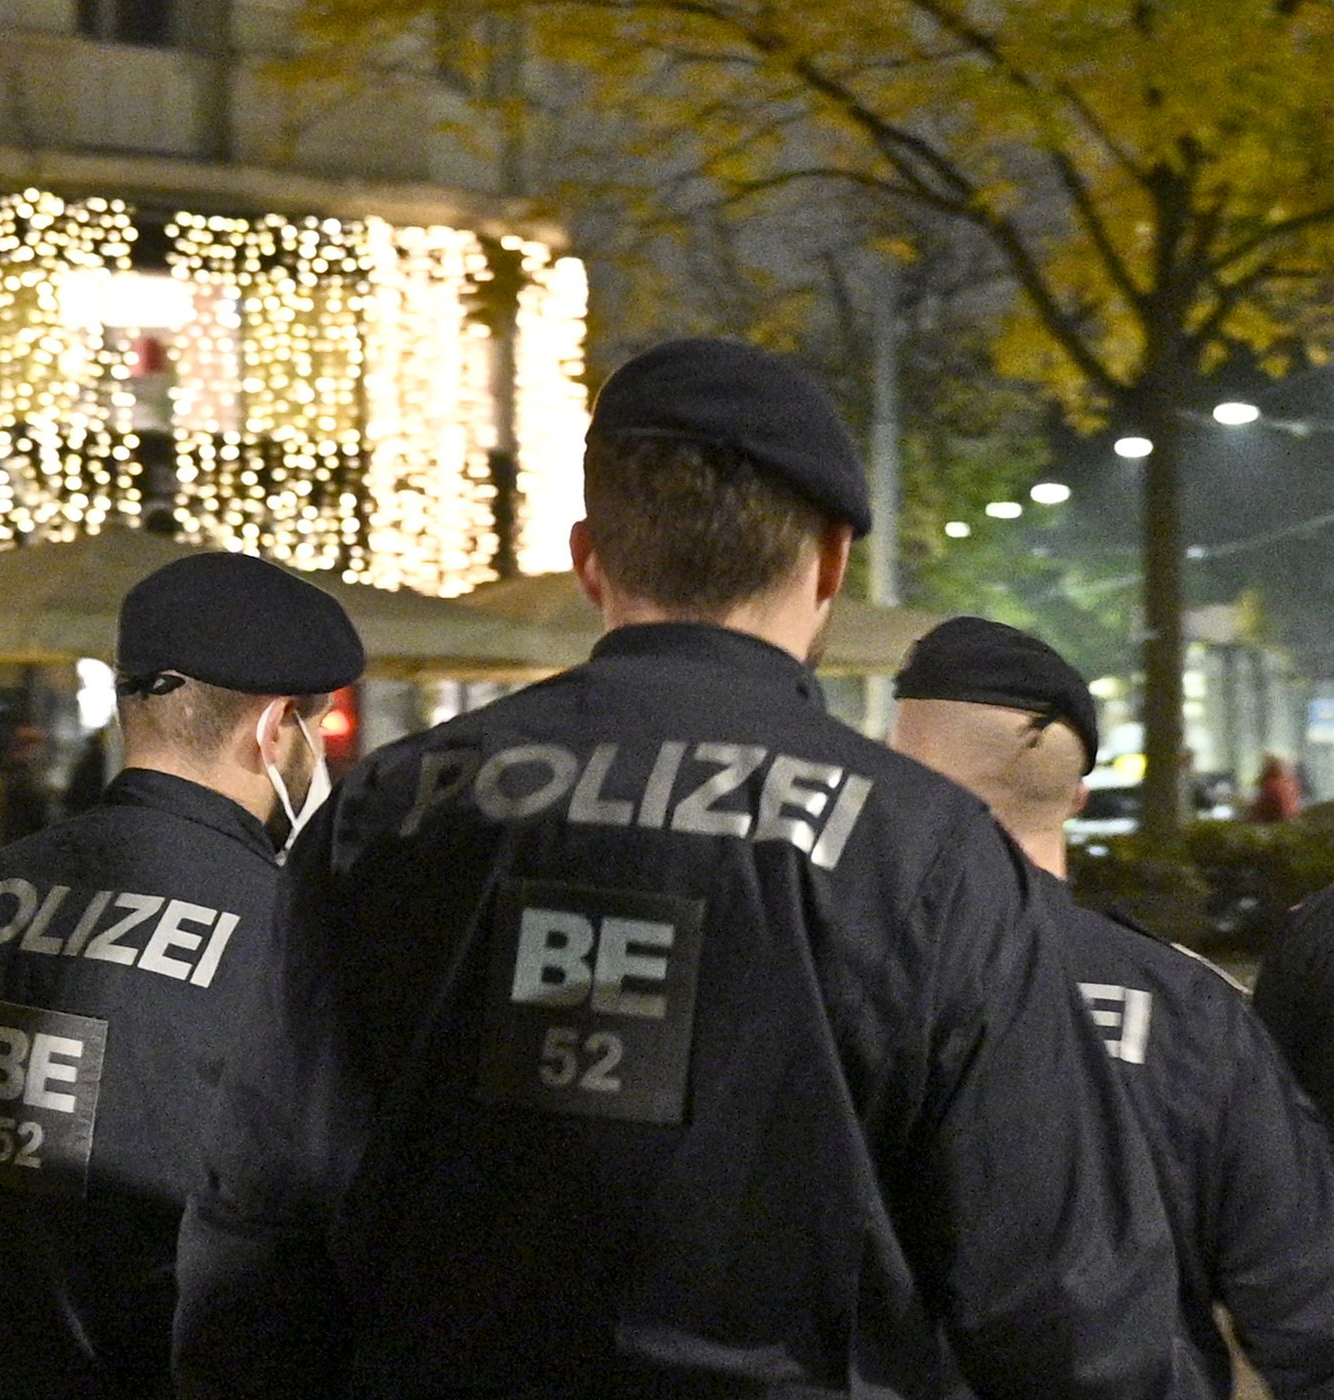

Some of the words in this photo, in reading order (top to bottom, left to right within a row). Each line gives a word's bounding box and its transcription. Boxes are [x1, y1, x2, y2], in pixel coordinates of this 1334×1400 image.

[399, 740, 874, 870] POLIZEI
[511, 907, 675, 1020] BE
[539, 1027, 624, 1092] 52
